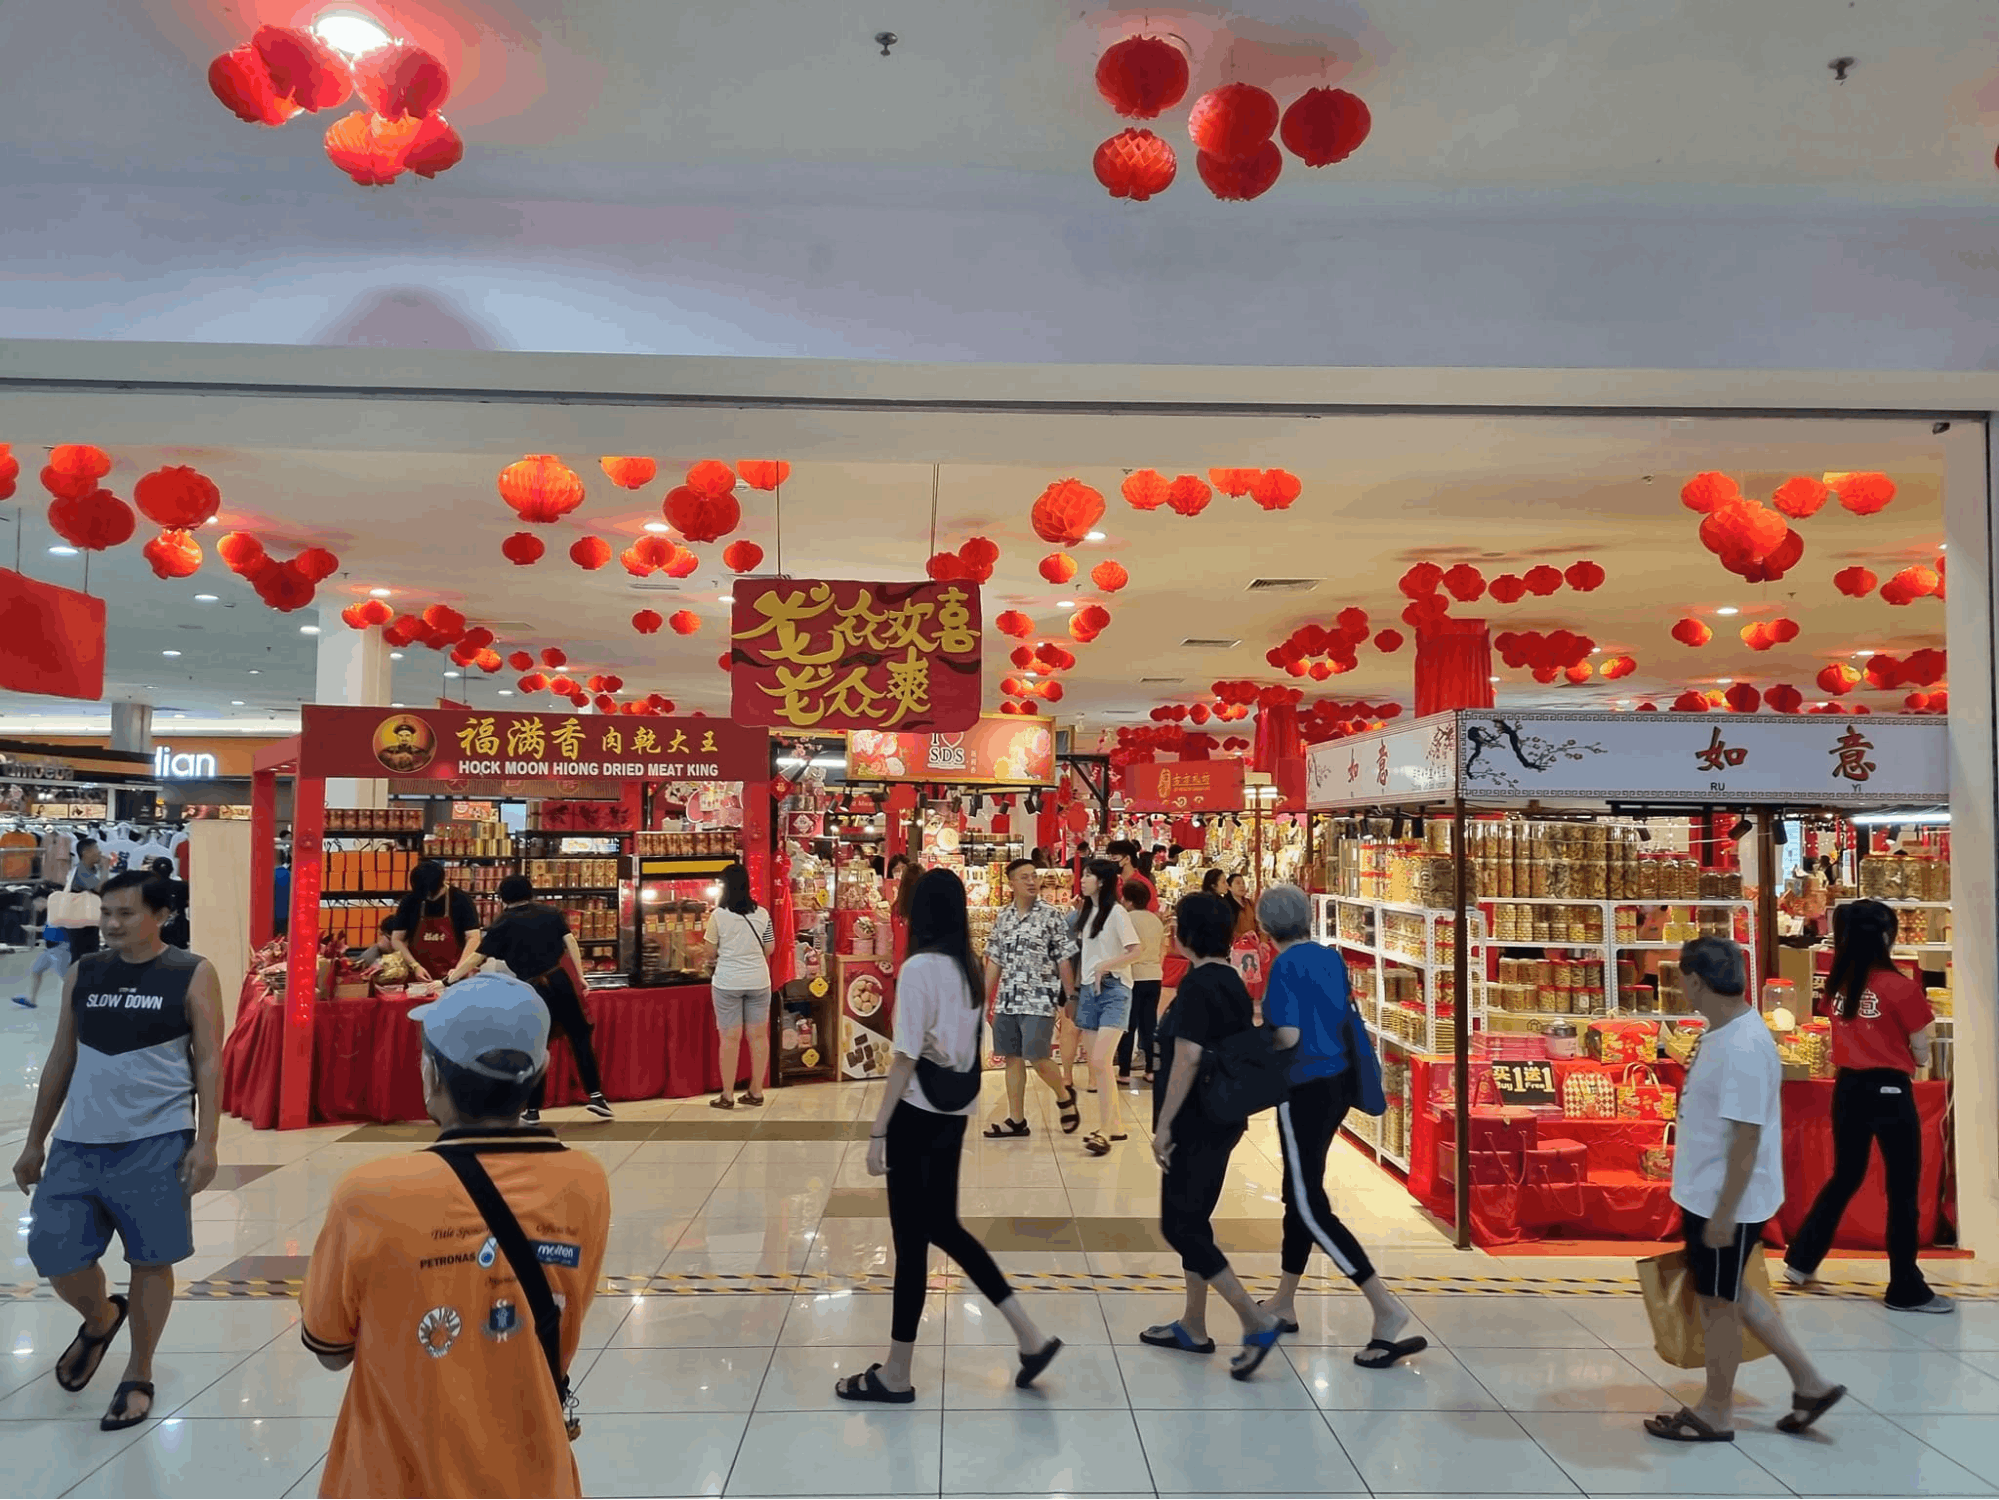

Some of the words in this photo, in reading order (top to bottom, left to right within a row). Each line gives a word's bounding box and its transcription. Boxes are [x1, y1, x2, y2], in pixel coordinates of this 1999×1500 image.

[458, 760, 500, 775] HOCK
[505, 761, 549, 775] MOON
[553, 761, 599, 776] HIONG
[603, 762, 644, 776] DRIED
[648, 763, 683, 777] MEAT
[687, 764, 719, 777] KING
[1710, 782, 1726, 791] RU
[86, 994, 122, 1008] SLOW
[125, 994, 163, 1010] DOWN
[538, 1245, 574, 1258] molten
[420, 1253, 476, 1269] PETRONAS
